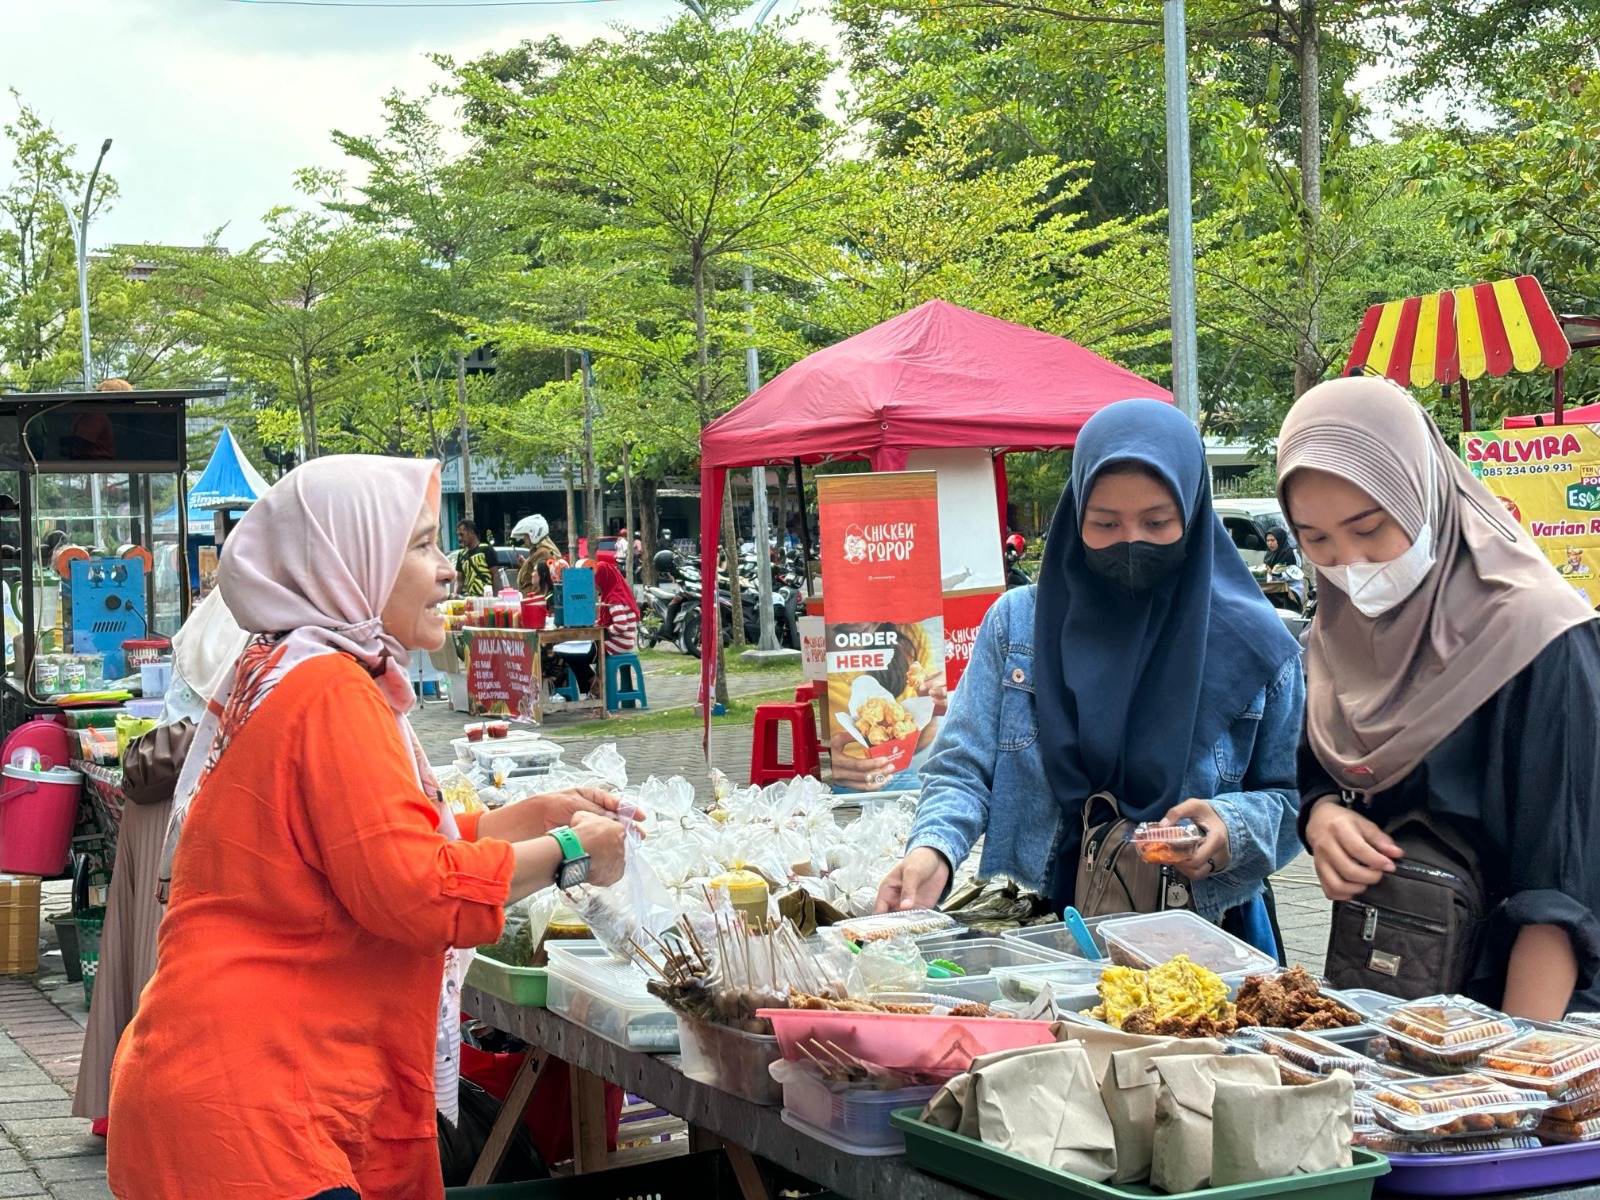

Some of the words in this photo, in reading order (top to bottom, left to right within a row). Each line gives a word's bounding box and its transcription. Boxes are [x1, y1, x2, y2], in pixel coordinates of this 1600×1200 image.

[1467, 433, 1582, 463] SALVIRA
[1482, 467, 1503, 477] 085
[1506, 466, 1527, 476] 234
[1529, 464, 1550, 474] 069
[1552, 463, 1573, 472] 931
[1531, 520, 1586, 537] Varian
[867, 540, 915, 563] POPOP
[834, 631, 899, 648] ORDER
[836, 652, 885, 669] HERE
